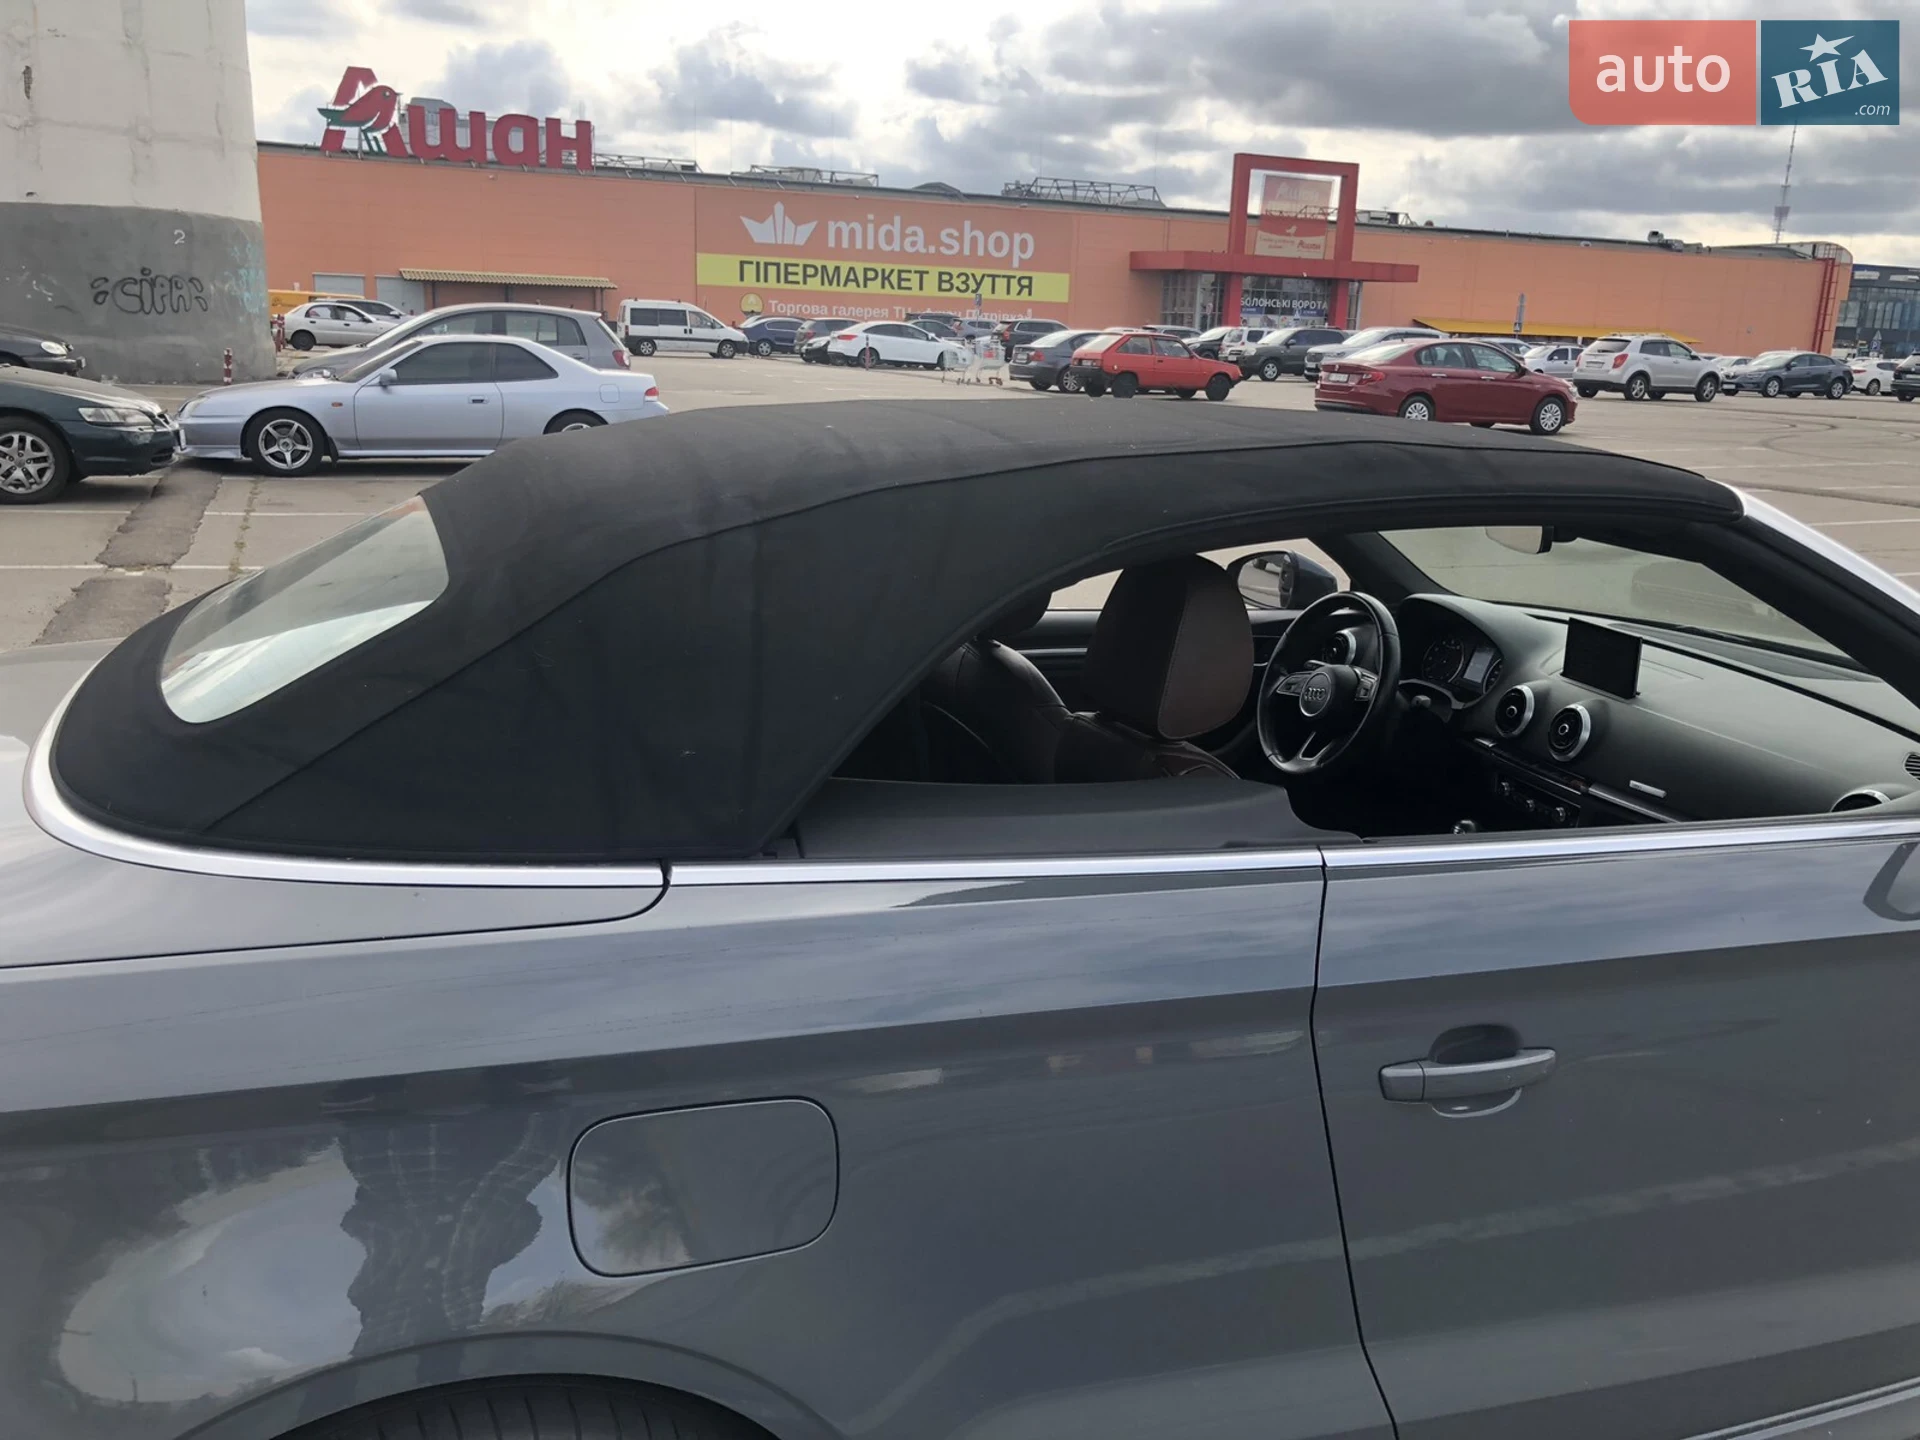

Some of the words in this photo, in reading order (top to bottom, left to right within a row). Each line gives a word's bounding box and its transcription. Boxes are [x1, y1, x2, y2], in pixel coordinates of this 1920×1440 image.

[320, 66, 593, 170] Ашан
[174, 229, 186, 244] 2
[827, 213, 1035, 268] mida.shop
[738, 259, 929, 292] ГІПЕРМАРКЕТ
[937, 270, 1034, 297] ВЗУТТЯ
[768, 300, 828, 316] Торгова
[832, 304, 889, 319] галерея
[1291, 299, 1328, 310] ВОРОТА
